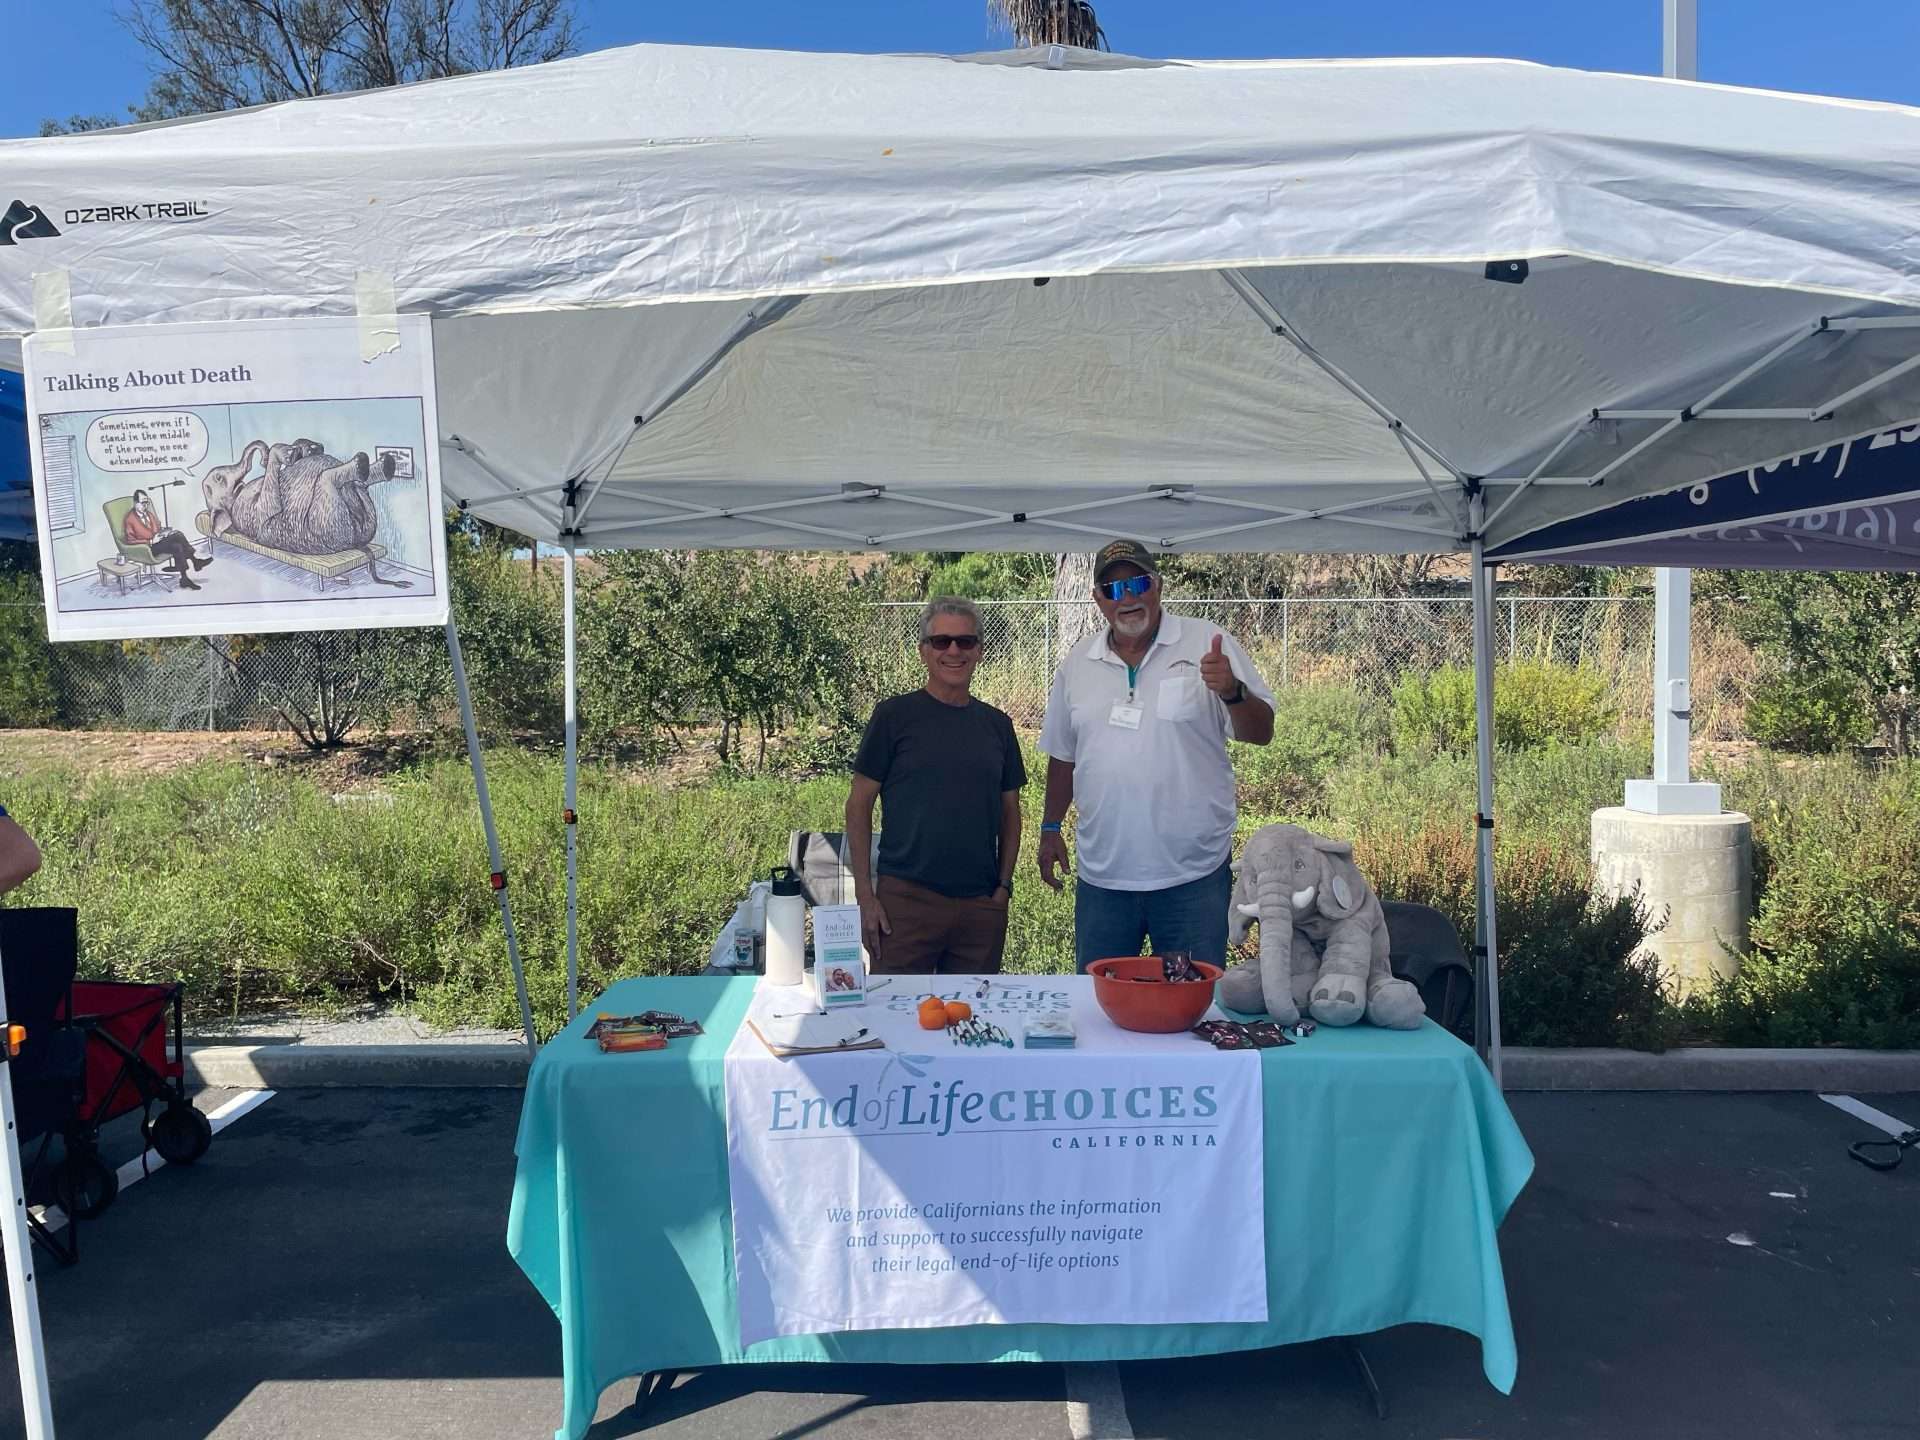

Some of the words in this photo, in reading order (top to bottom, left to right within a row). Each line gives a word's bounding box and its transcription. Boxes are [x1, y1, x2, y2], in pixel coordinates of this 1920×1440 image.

[65, 205, 141, 224] OZARK
[44, 372, 119, 392] Talking
[124, 369, 186, 387] About
[190, 365, 252, 384] Death
[150, 420, 171, 429] even
[174, 417, 183, 427] if
[100, 432, 126, 443] stand
[129, 432, 138, 441] in
[141, 431, 157, 441] the
[159, 428, 191, 439] middle
[104, 444, 113, 454] of
[116, 444, 131, 454] the
[160, 444, 171, 452] no
[172, 443, 188, 451] one
[109, 454, 168, 466] acknowledges
[1002, 990, 1069, 1001] Life
[768, 1084, 858, 1131] End
[863, 1089, 898, 1130] of
[898, 1080, 984, 1136] Life
[989, 1085, 1218, 1122] CHOICES
[1052, 1135, 1216, 1149] CALIFORNIA
[827, 1208, 851, 1223] We
[856, 1204, 918, 1225] provide
[923, 1200, 1024, 1222] Californians
[1029, 1200, 1056, 1216] the
[1060, 1198, 1161, 1219] information
[846, 1231, 878, 1248] and
[882, 1231, 945, 1249] support
[950, 1231, 966, 1244] to
[971, 1226, 1066, 1246] successfully
[1071, 1225, 1143, 1244] navigate
[872, 1256, 912, 1273] their
[916, 1256, 956, 1275] legal
[960, 1252, 1053, 1273] end-of-life
[1058, 1252, 1120, 1272] options
